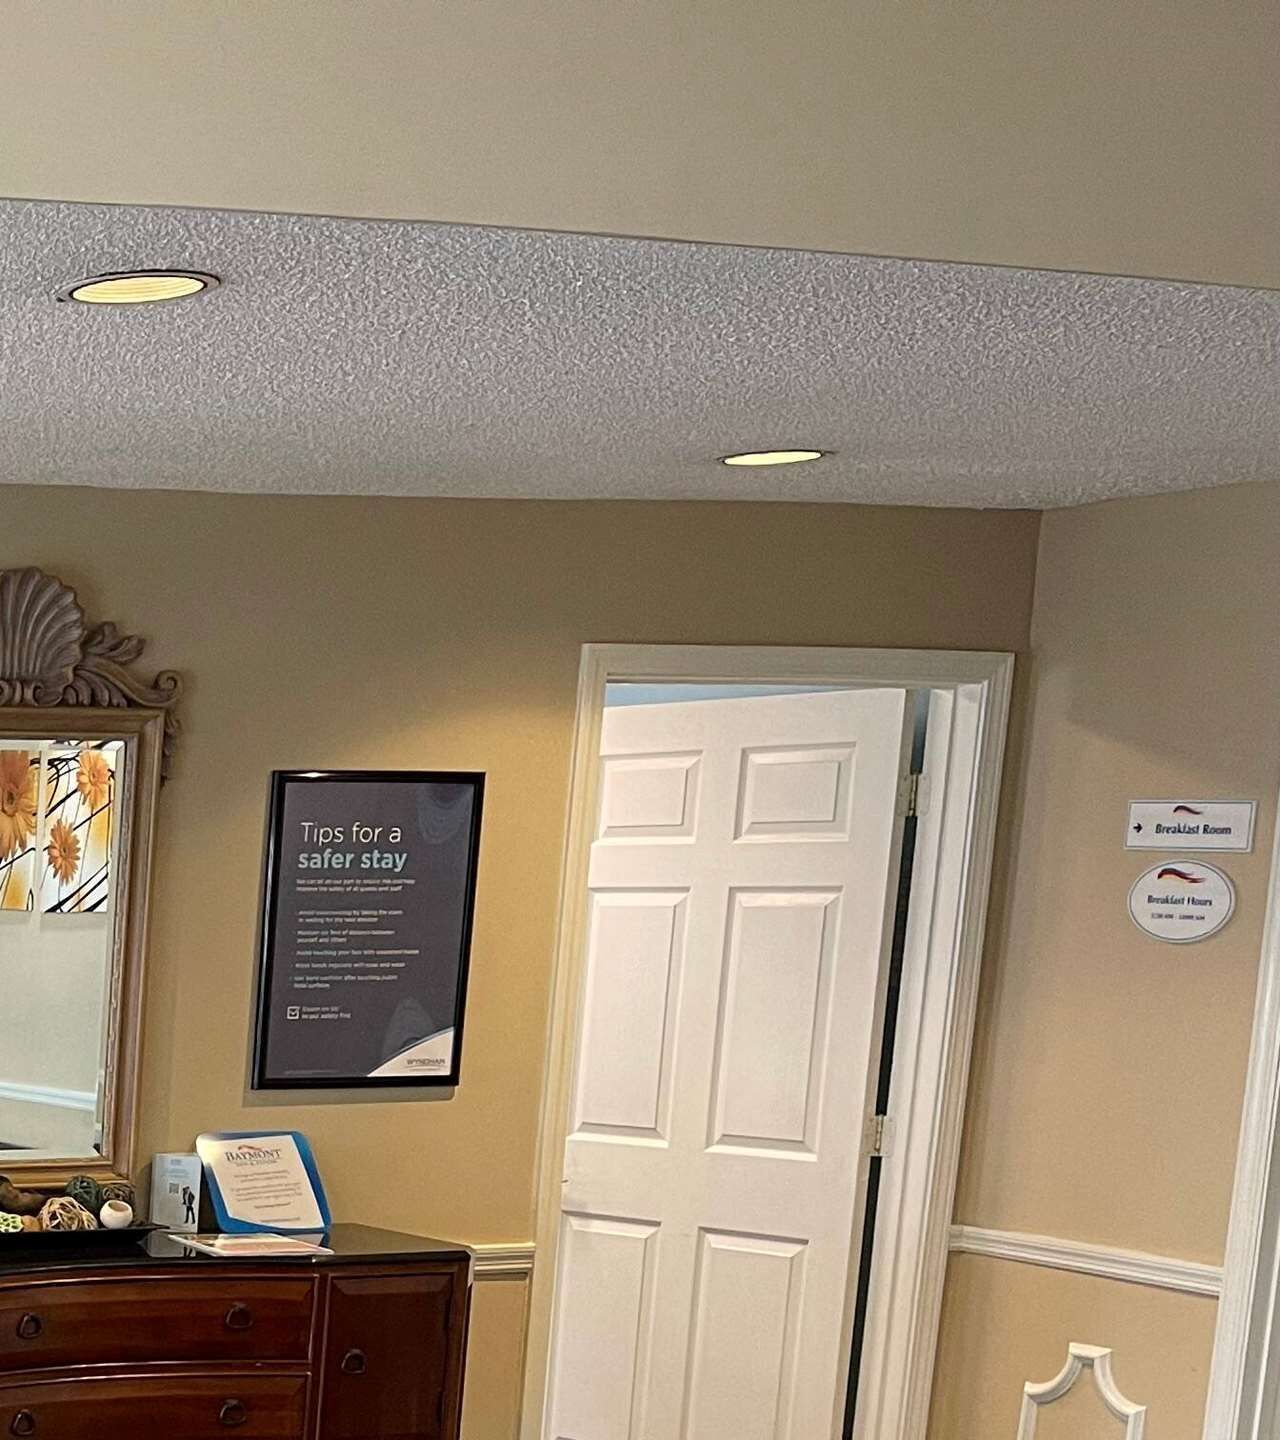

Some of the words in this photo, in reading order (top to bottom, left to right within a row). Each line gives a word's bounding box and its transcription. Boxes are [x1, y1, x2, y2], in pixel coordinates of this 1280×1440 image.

[300, 821, 344, 847] Tips
[352, 821, 383, 843] for
[389, 827, 401, 843] a
[1155, 823, 1200, 835] Breakfast
[1202, 824, 1232, 835] Room
[298, 848, 355, 869] safer
[360, 849, 408, 873] stay
[1147, 894, 1185, 905] Breakfast
[1187, 896, 1212, 906] Hours
[225, 1149, 282, 1162] BAYMONT
